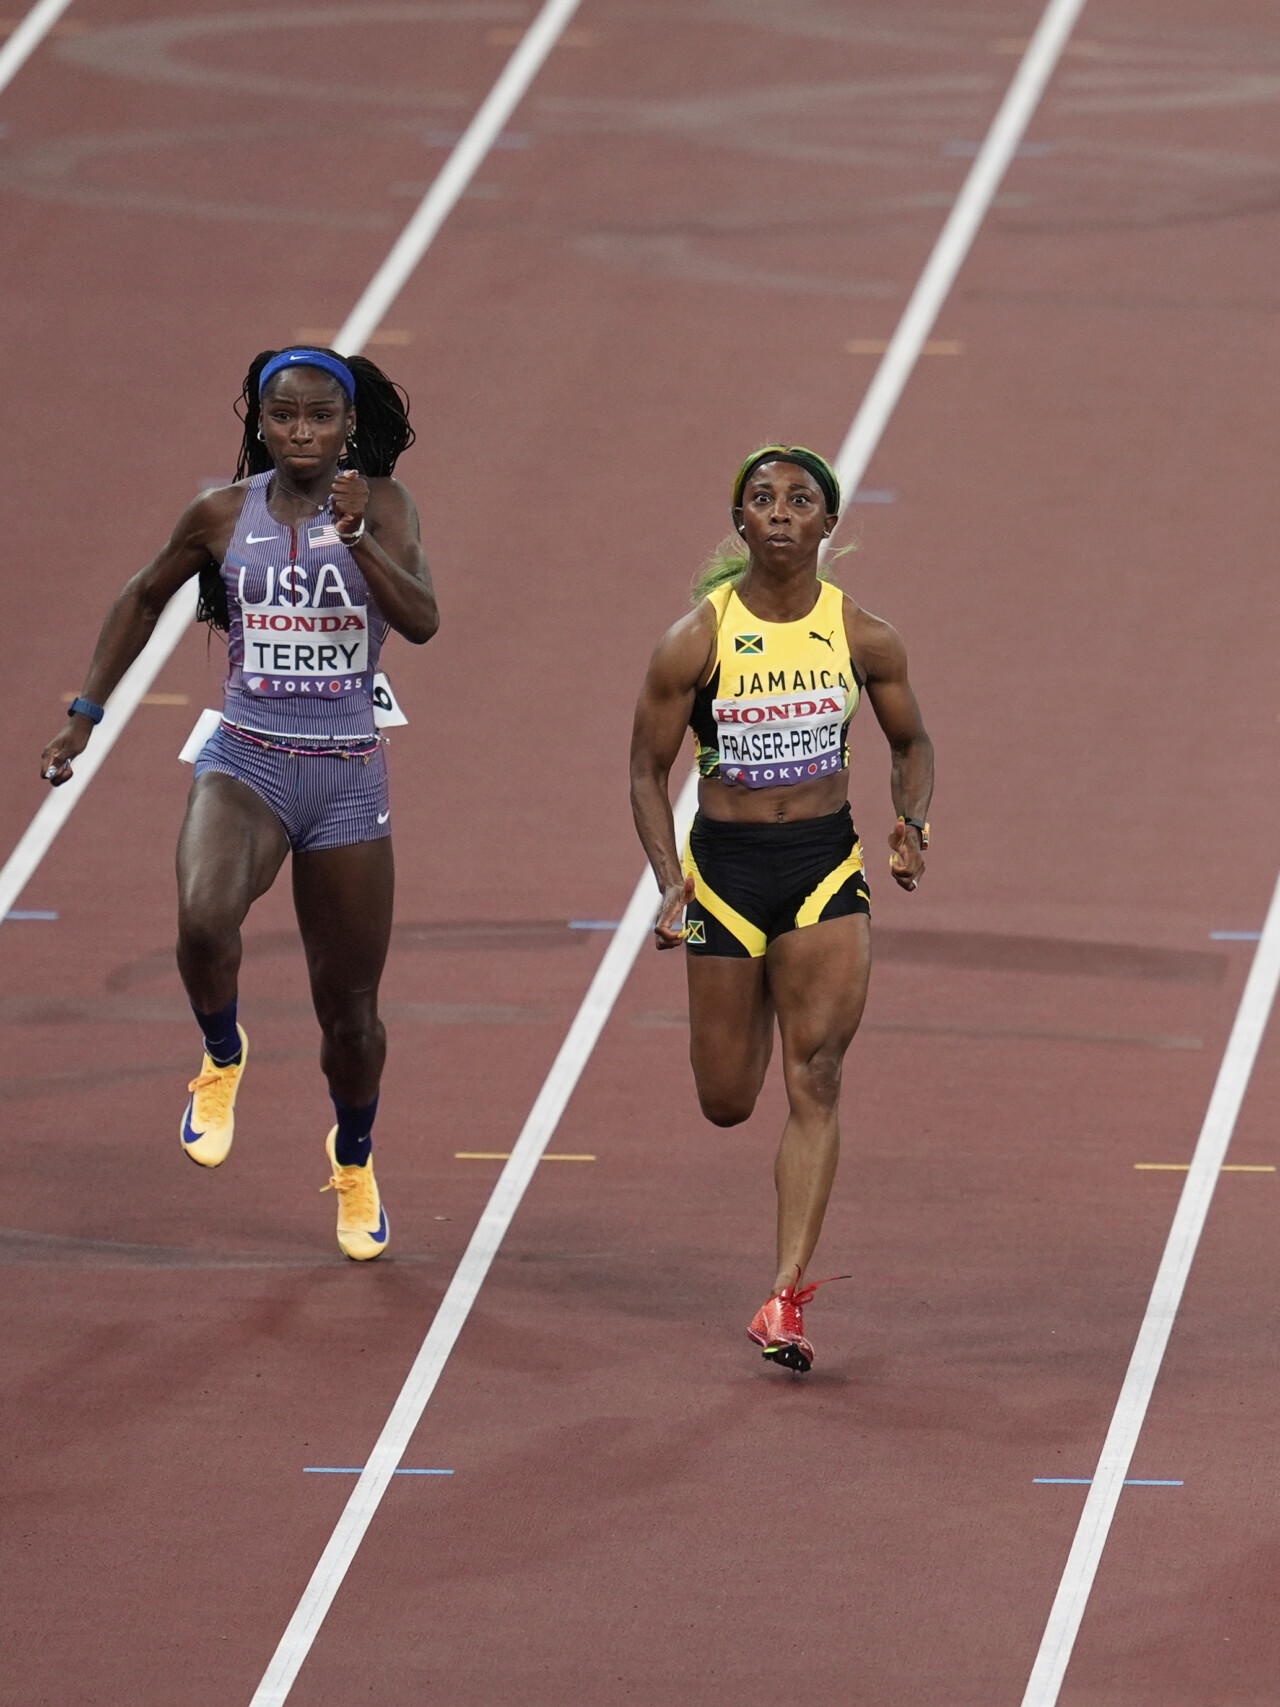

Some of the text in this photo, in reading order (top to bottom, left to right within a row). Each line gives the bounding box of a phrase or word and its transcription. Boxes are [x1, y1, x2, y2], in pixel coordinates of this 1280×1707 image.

[238, 563, 352, 607] USA
[245, 613, 366, 632] HONDA
[253, 642, 360, 671] TERRY
[734, 670, 849, 697] JAMAICA
[715, 697, 842, 724] HONDA
[721, 723, 838, 762] FRASER-PRYCE
